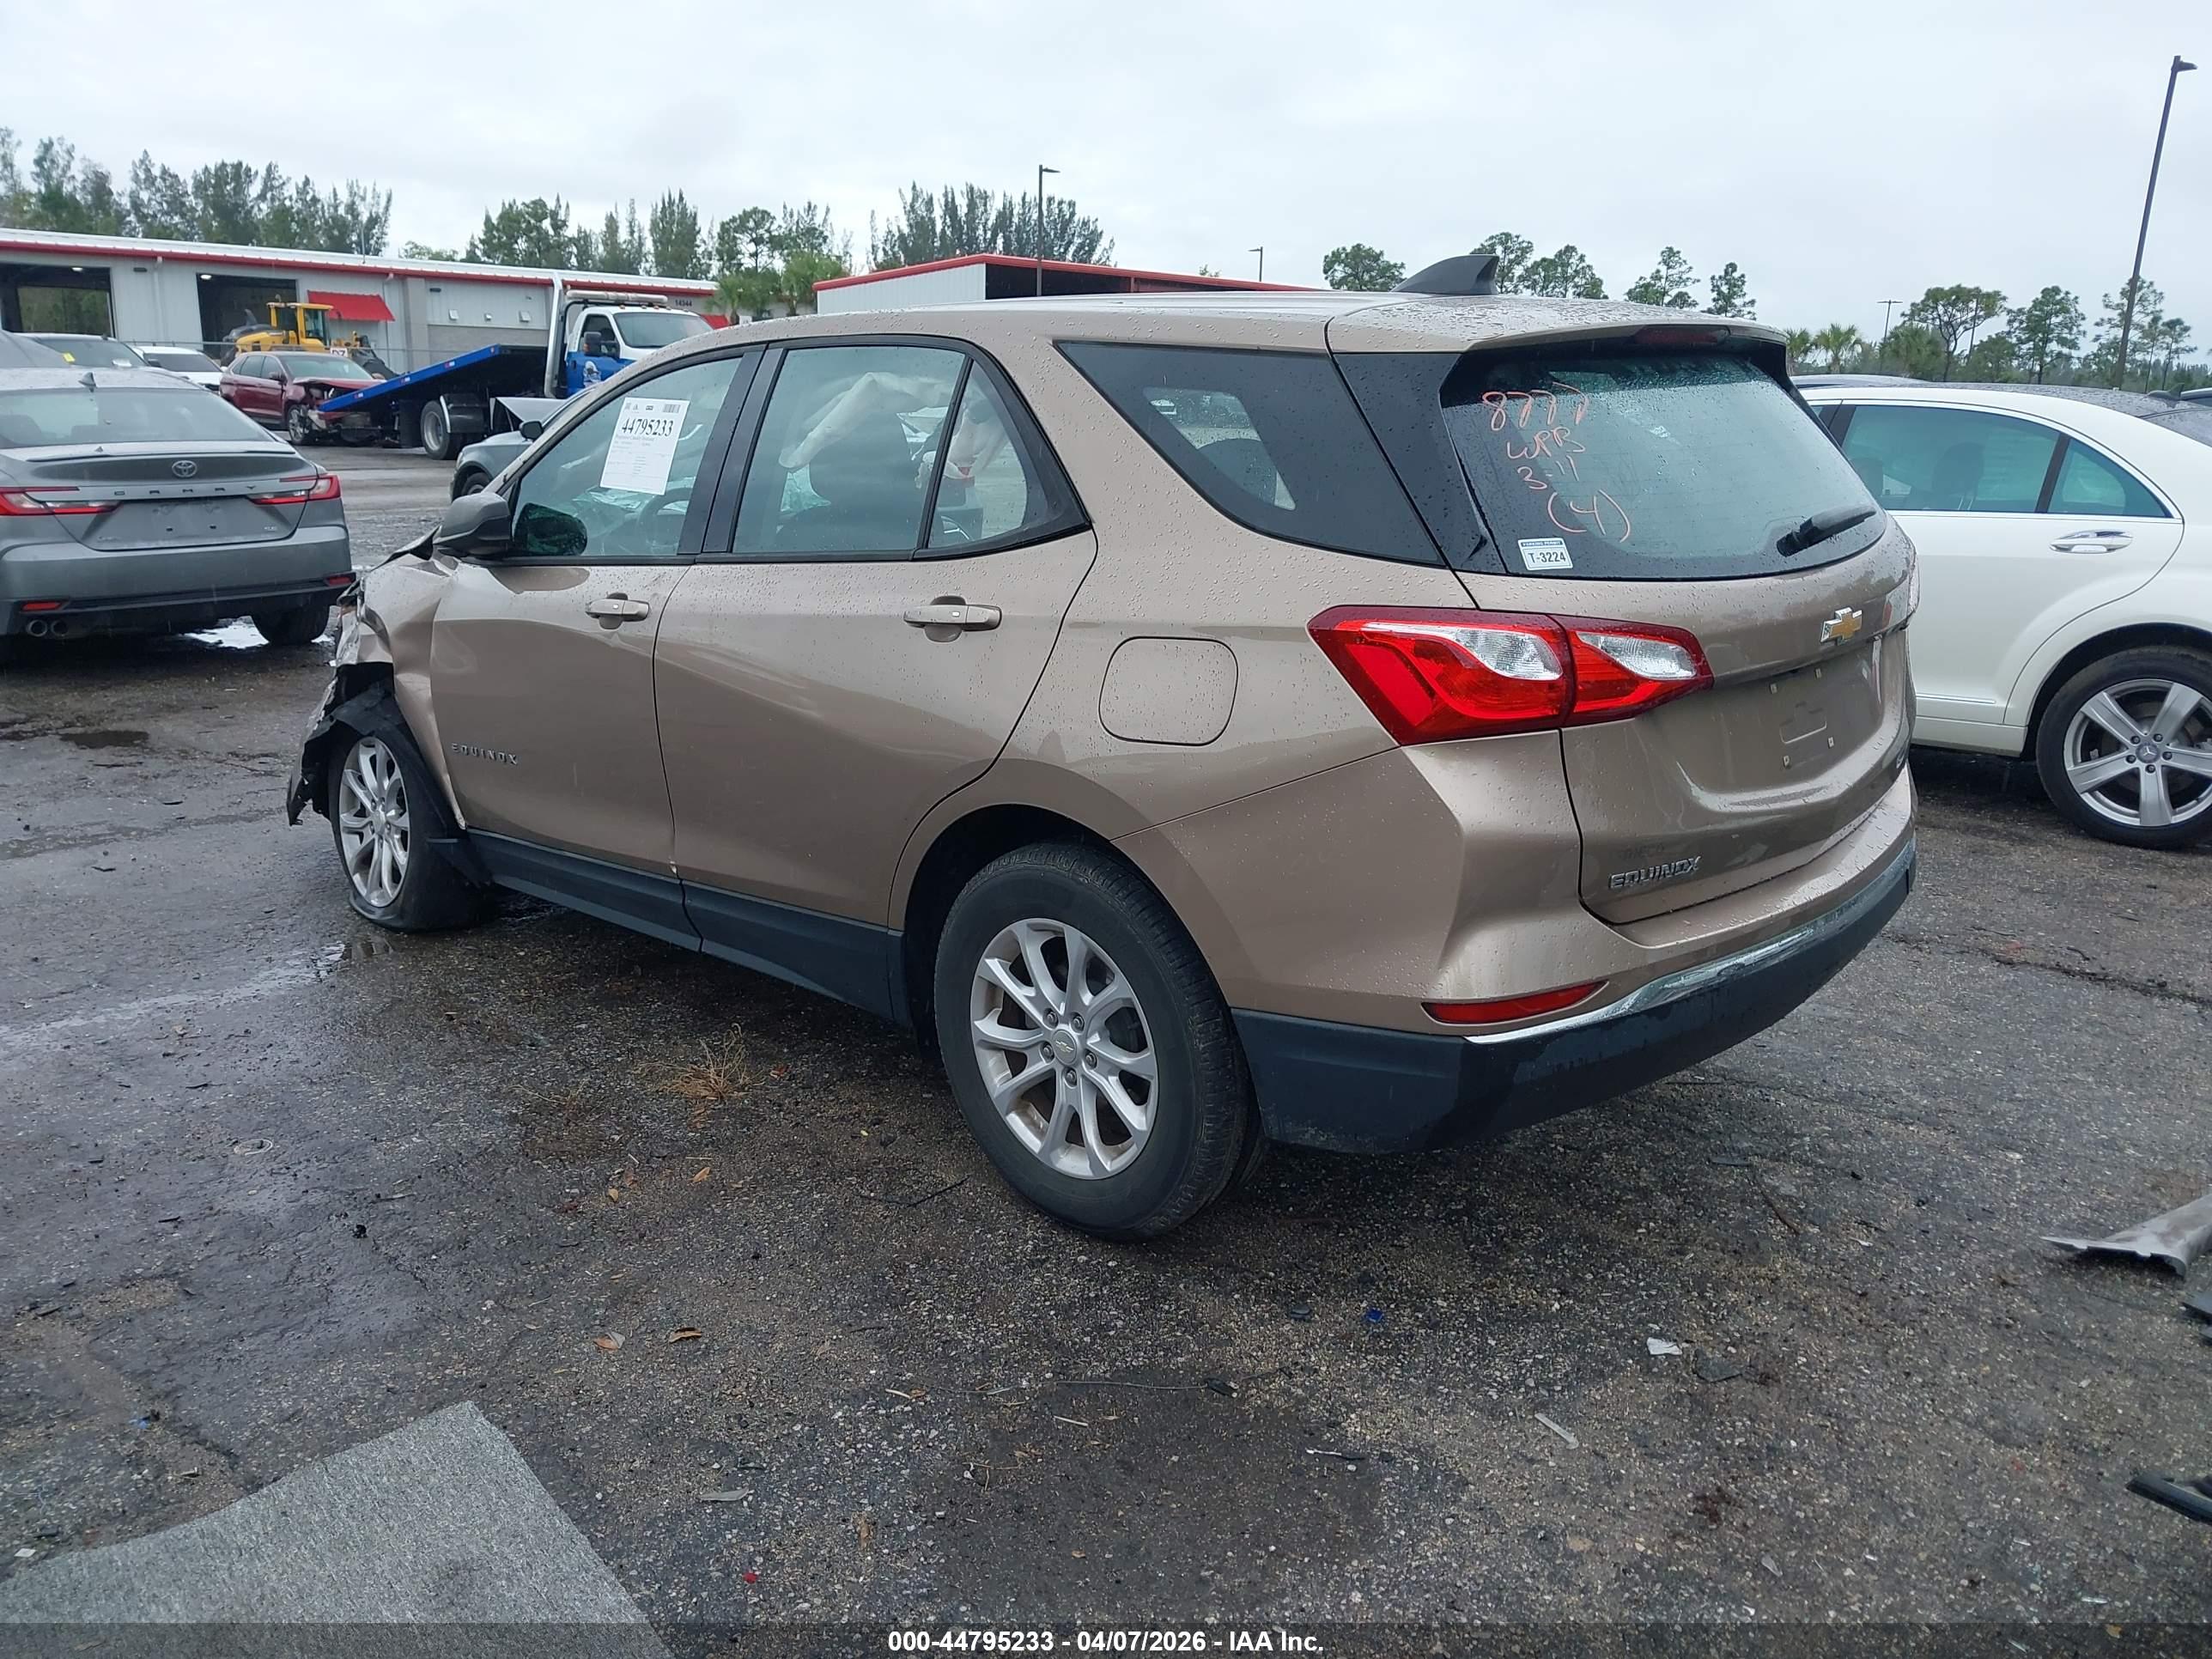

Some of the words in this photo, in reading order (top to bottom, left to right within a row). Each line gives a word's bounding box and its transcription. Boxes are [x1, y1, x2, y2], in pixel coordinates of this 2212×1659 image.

[622, 417, 674, 437] 44795233
[1547, 489, 1632, 543] (4)
[1528, 551, 1566, 564] T-3224
[451, 742, 519, 765] EQUINOX
[1608, 855, 1702, 889] EQUINOX
